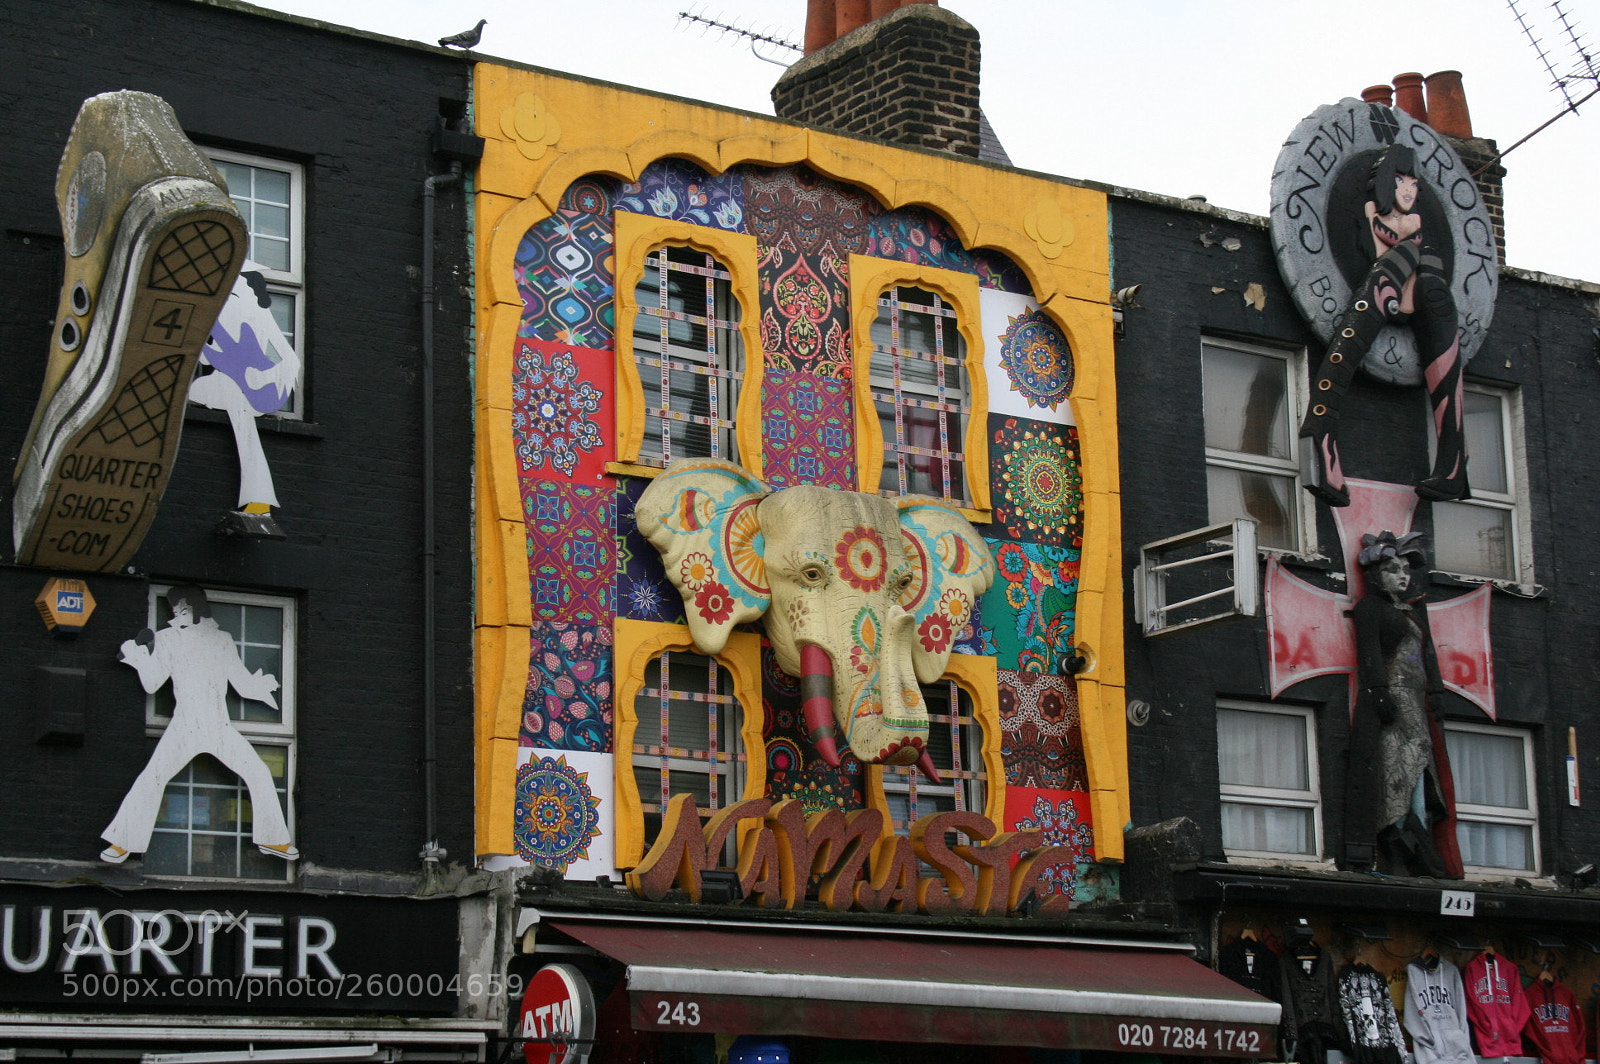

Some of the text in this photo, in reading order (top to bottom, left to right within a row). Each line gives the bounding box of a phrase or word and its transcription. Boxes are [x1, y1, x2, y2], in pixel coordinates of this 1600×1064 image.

[1286, 108, 1493, 296] NEW ROCK
[153, 308, 183, 340] 4
[59, 454, 162, 489] QUARTER
[57, 493, 134, 524] SHOES
[57, 596, 83, 609] ADT
[1444, 895, 1472, 910] 245
[1, 904, 344, 981] UARTER
[522, 999, 573, 1038] ATM
[657, 1000, 701, 1026] 243
[1118, 1023, 1260, 1052] 020 7284 1742
